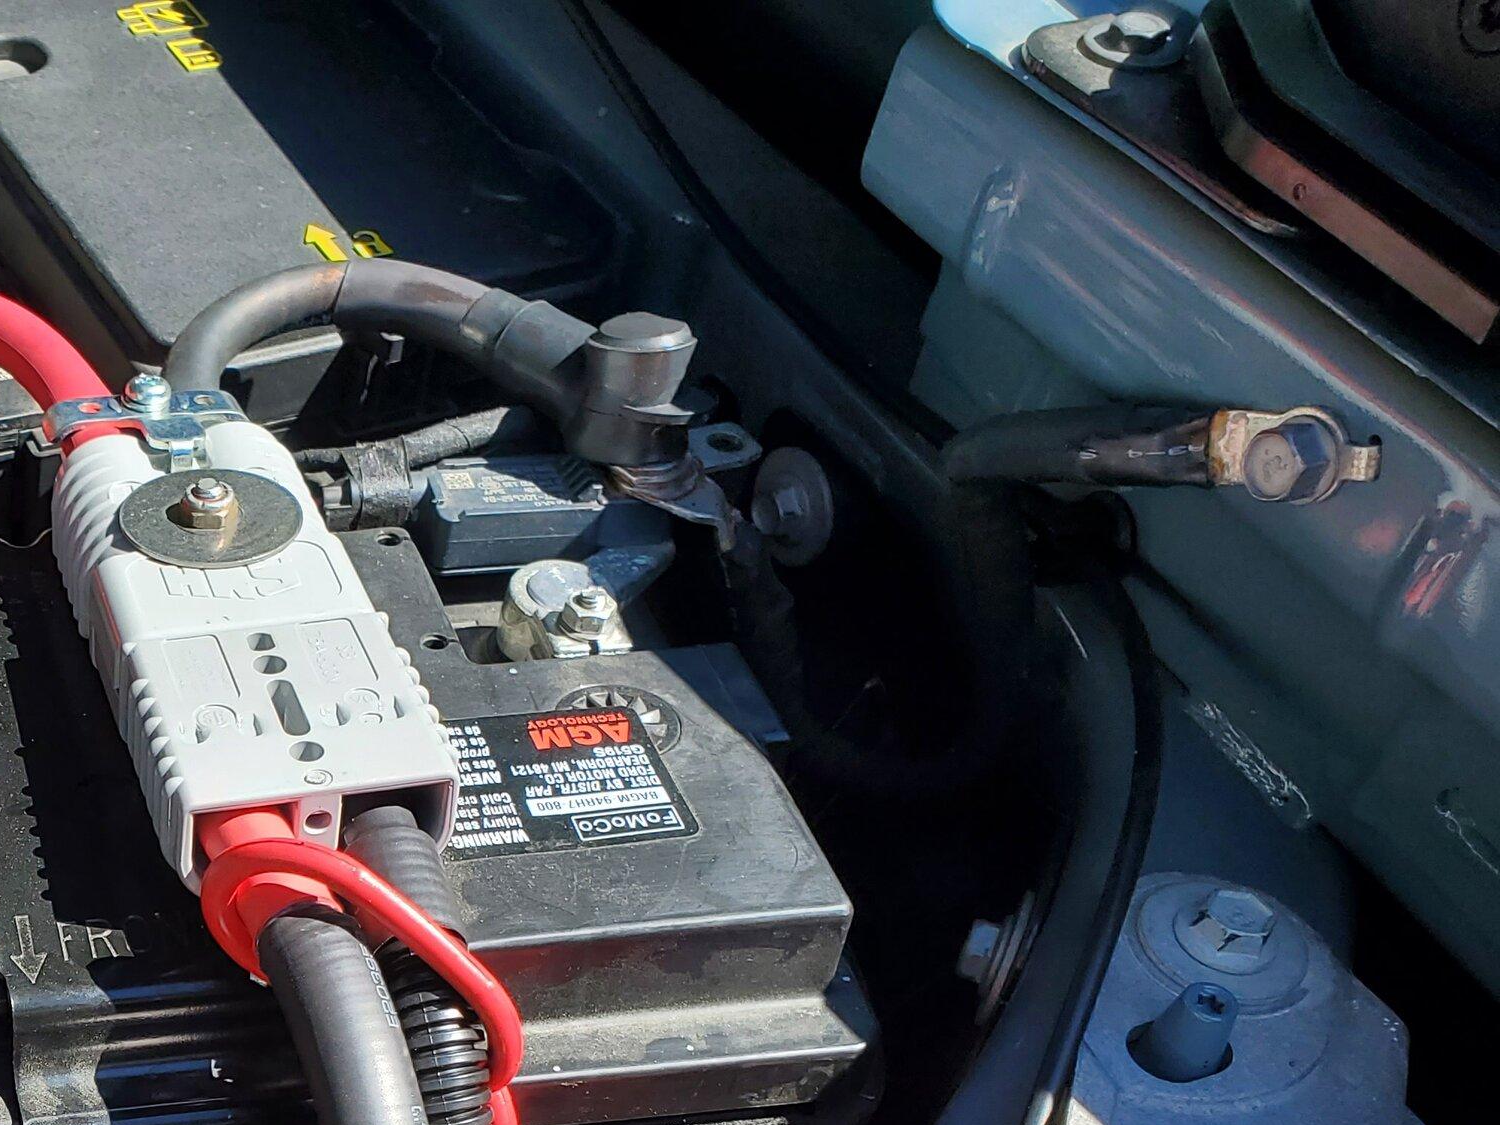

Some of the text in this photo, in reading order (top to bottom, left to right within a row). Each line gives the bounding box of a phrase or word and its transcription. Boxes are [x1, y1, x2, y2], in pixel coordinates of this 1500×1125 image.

[527, 712, 627, 730] TECHNOLOGY
[528, 720, 629, 750] AGM
[510, 762, 548, 776] 48121
[539, 764, 656, 785] FORD MOTOR CO.
[550, 761, 570, 773] MI
[525, 774, 661, 797] DIST. BY DISTR. PAR
[578, 810, 678, 833] FoMoCo
